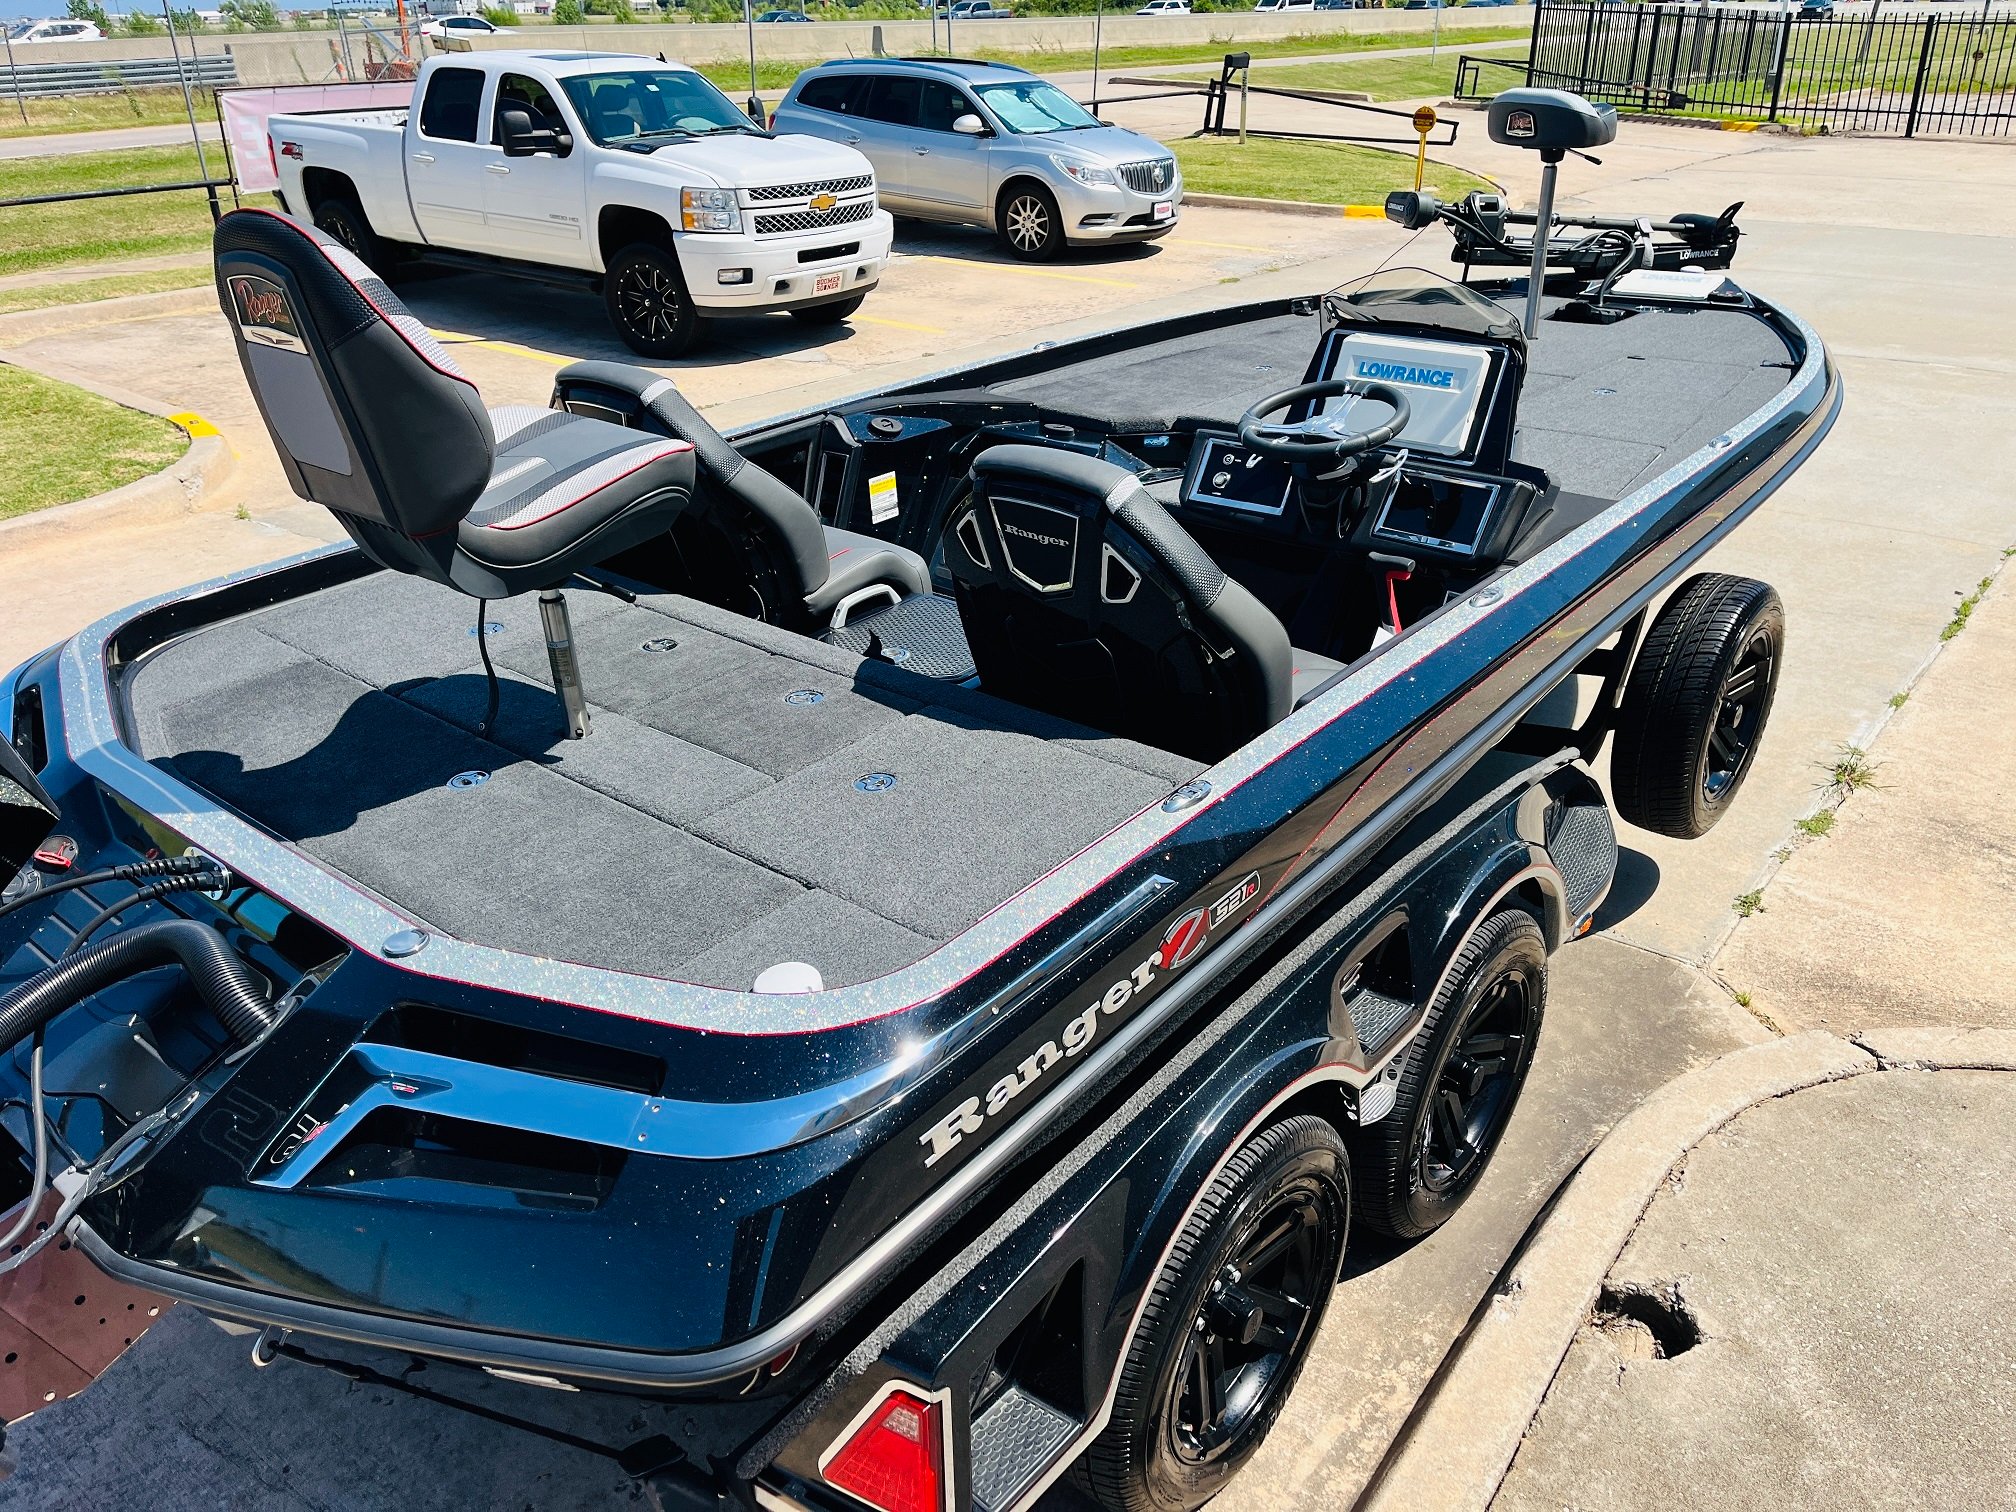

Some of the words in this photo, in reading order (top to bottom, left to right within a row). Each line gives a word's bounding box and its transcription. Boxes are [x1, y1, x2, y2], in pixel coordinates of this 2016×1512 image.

[1680, 248, 1719, 260] LOWRANCE
[816, 275, 841, 286] BOOMER
[1358, 361, 1454, 388] LOWRANCE
[1003, 523, 1069, 547] Ranger
[918, 950, 1164, 1168] Ranger
